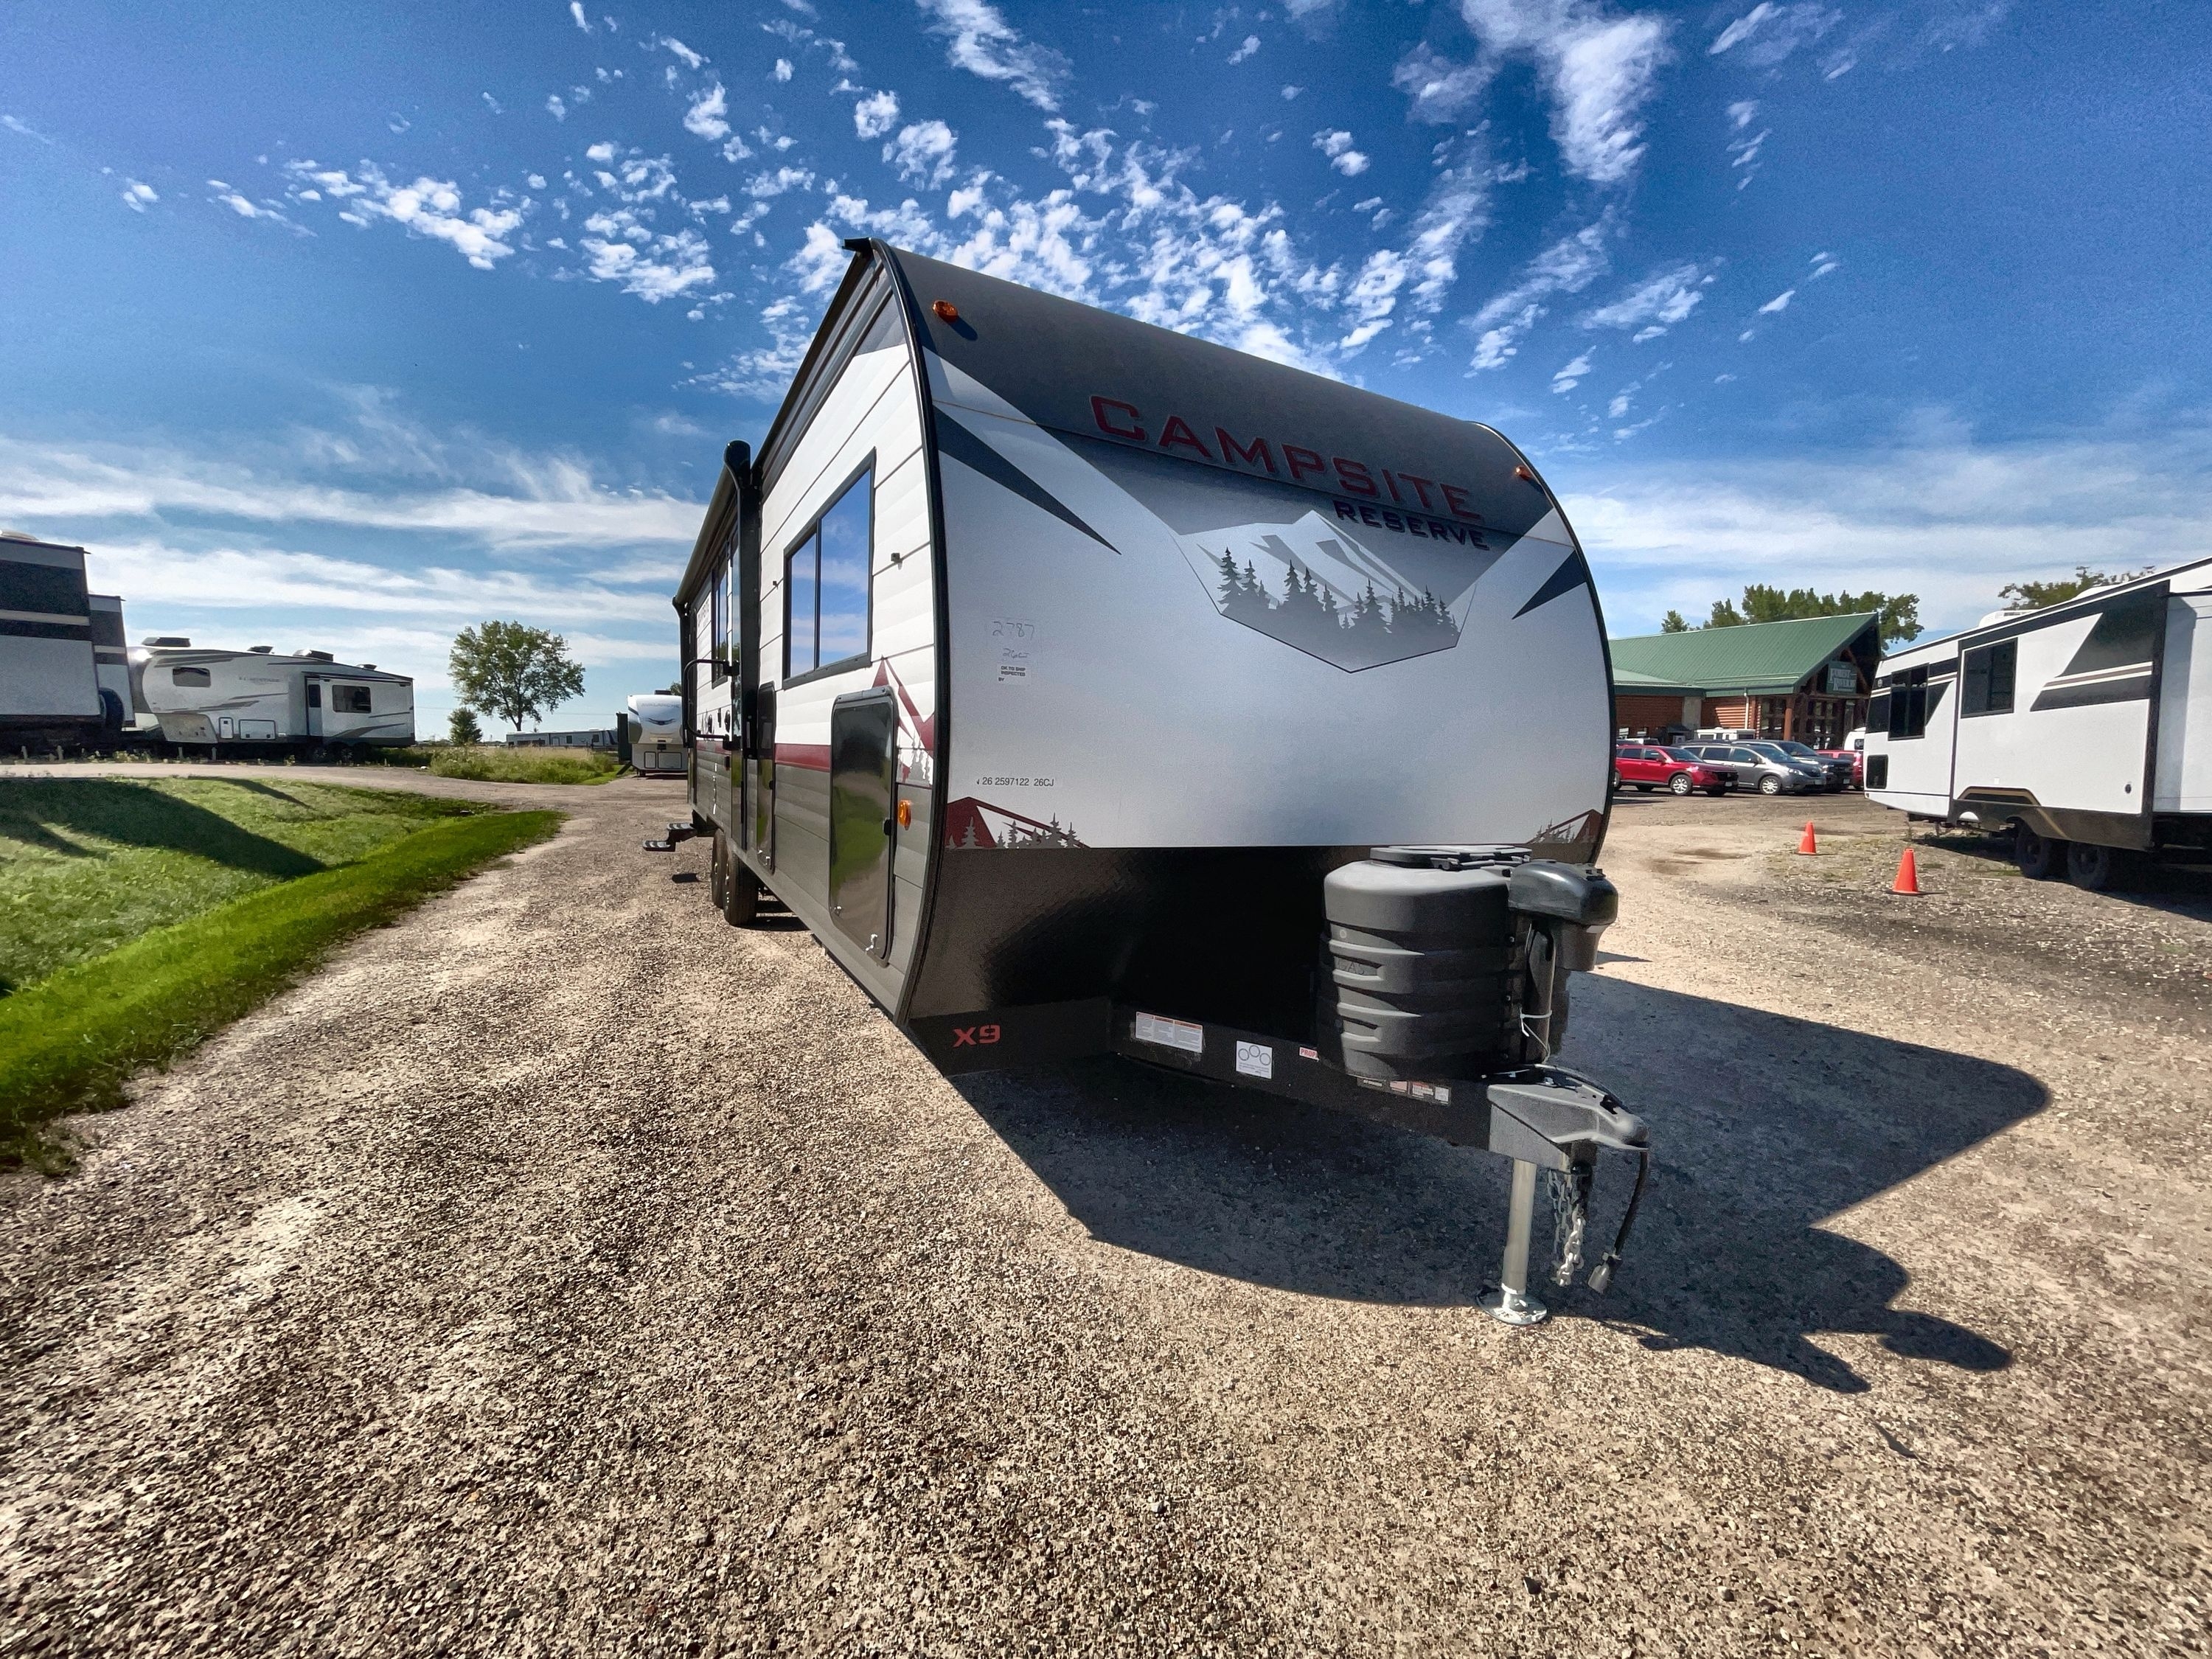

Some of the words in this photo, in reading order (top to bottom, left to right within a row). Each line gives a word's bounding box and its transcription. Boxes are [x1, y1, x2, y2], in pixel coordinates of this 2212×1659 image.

[1090, 394, 1484, 521] CAMPSITE
[1332, 499, 1490, 551] RESERVE
[992, 621, 1034, 641] 2787
[982, 776, 992, 785] 26
[995, 777, 1029, 787] 2597122
[1034, 778, 1054, 787] 26CJ
[953, 1025, 1001, 1048] X9
[1300, 1048, 1318, 1058] PROP
